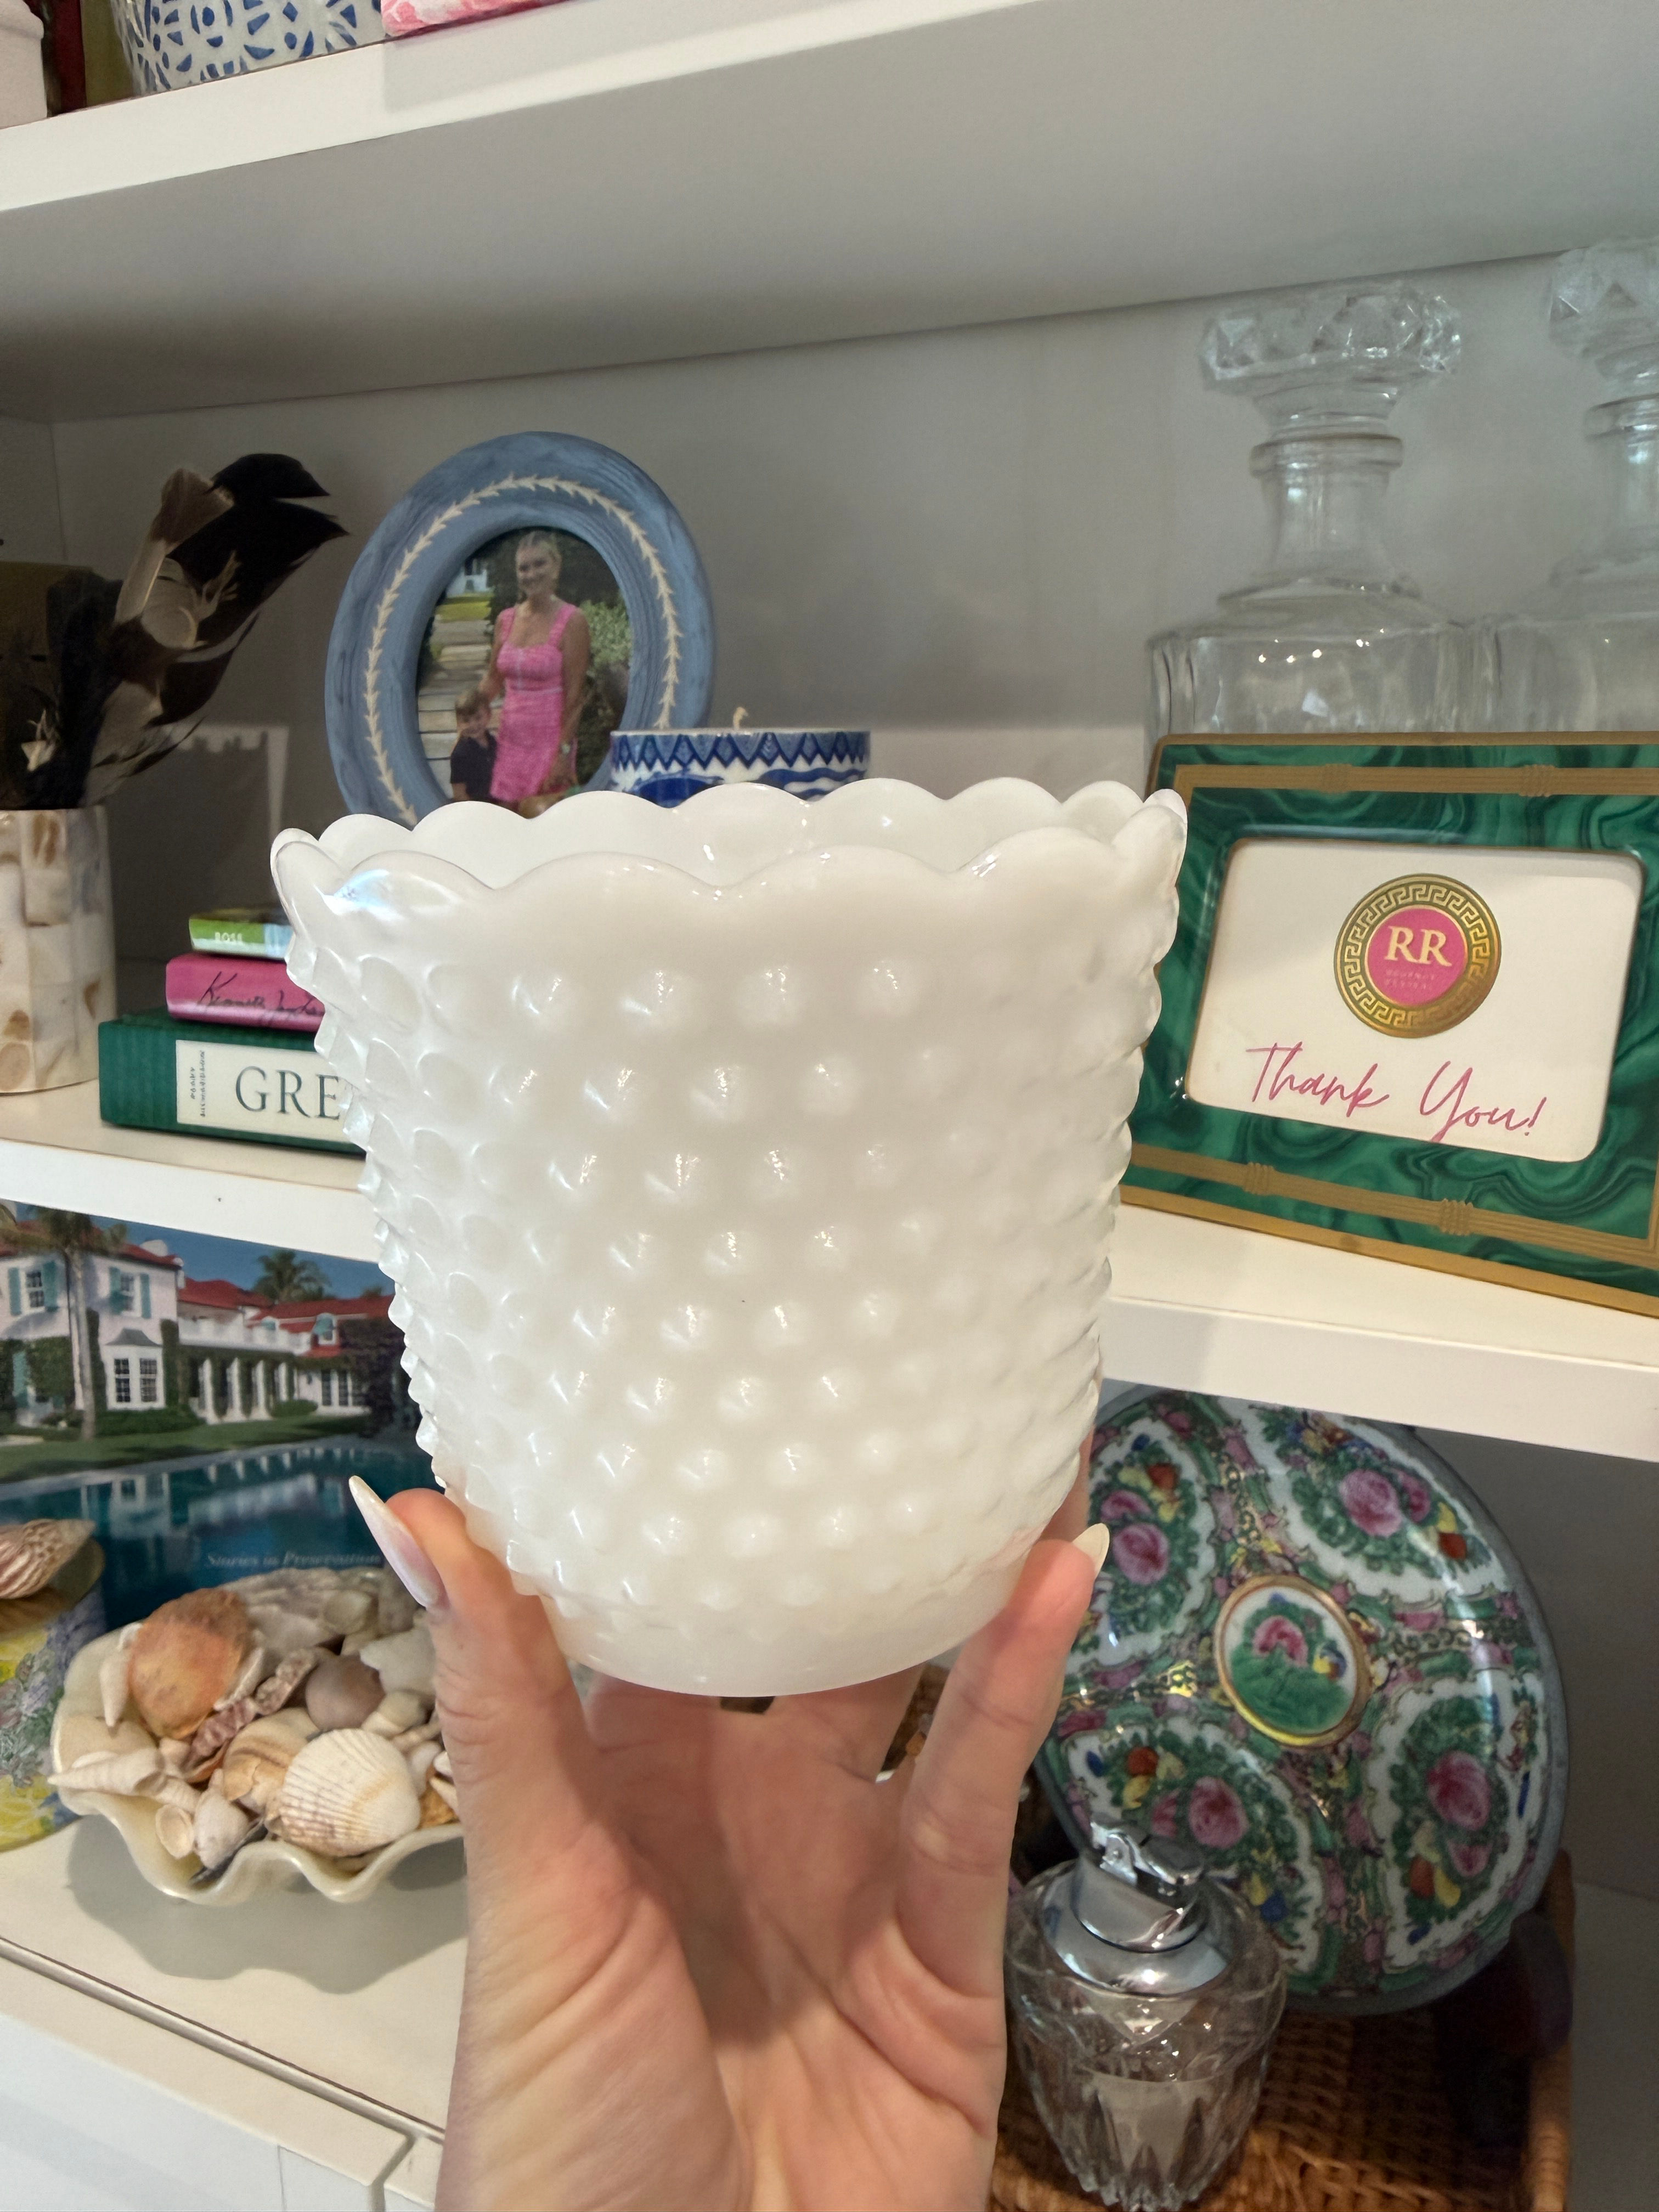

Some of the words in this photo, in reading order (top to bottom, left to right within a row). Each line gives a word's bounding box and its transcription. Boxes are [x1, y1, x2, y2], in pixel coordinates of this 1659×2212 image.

[1384, 926, 1453, 967] RR
[1246, 1041, 1390, 1117] Thank
[1419, 1060, 1547, 1143] You!
